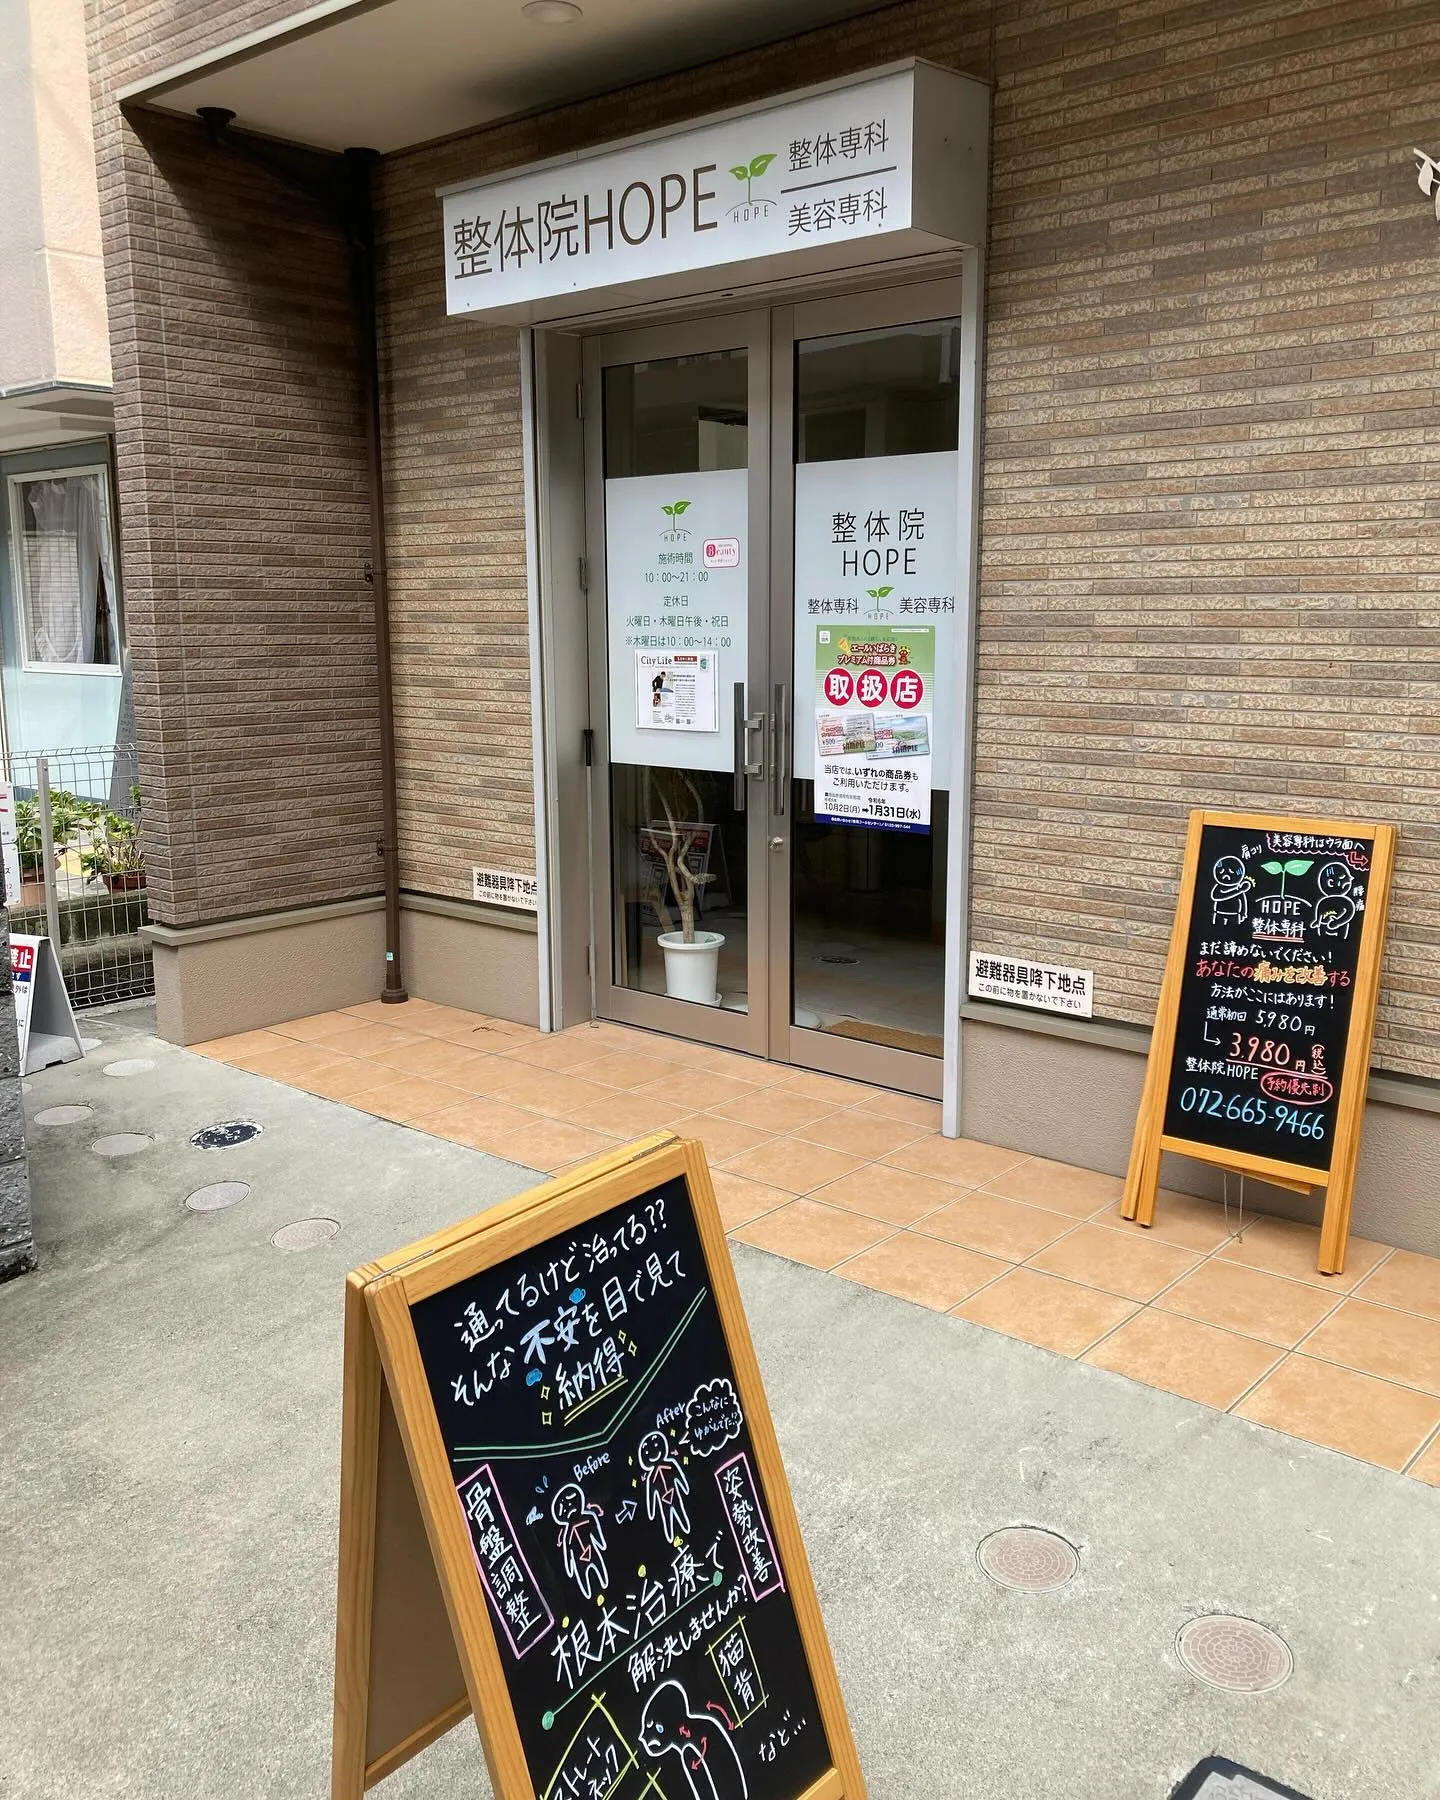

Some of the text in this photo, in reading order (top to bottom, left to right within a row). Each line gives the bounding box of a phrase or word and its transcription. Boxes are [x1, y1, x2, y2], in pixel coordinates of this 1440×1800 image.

[787, 118, 889, 173] 整体専科
[453, 162, 718, 281] 整体院HOPE
[733, 204, 770, 224] HOPE
[787, 186, 888, 236] 美容専科
[663, 533, 687, 542] HOPE
[831, 507, 925, 544] 整体院
[658, 552, 693, 565] 施術時間
[842, 547, 917, 577] HOPE
[663, 595, 689, 607] 定休日
[807, 598, 859, 615] 整体専科
[899, 596, 955, 614] 美容専科
[828, 673, 919, 703] 取扱店
[833, 777, 910, 792] ご利用いただけます。
[1241, 844, 1262, 860] 肩コリ
[1261, 900, 1301, 916] HOPE
[1252, 917, 1306, 938] 整体専科
[975, 958, 1086, 996] 避難器具降下地点
[1195, 959, 1351, 987] あなたの痛みを改善する
[978, 982, 1081, 1009] この前に物を置かないで下さい
[1206, 1006, 1247, 1022] 通常初回
[1185, 1056, 1258, 1080] 整体院HOPE
[1180, 1087, 1325, 1140] 072-665-9466
[554, 1336, 625, 1410] 納得
[656, 1402, 686, 1429] After
[573, 1452, 611, 1482] Before
[723, 1466, 770, 1583] 姿勢改善
[465, 1482, 542, 1641] 骨盤調整
[551, 1529, 724, 1690] 根本治療で
[717, 1632, 756, 1711] 猫背
